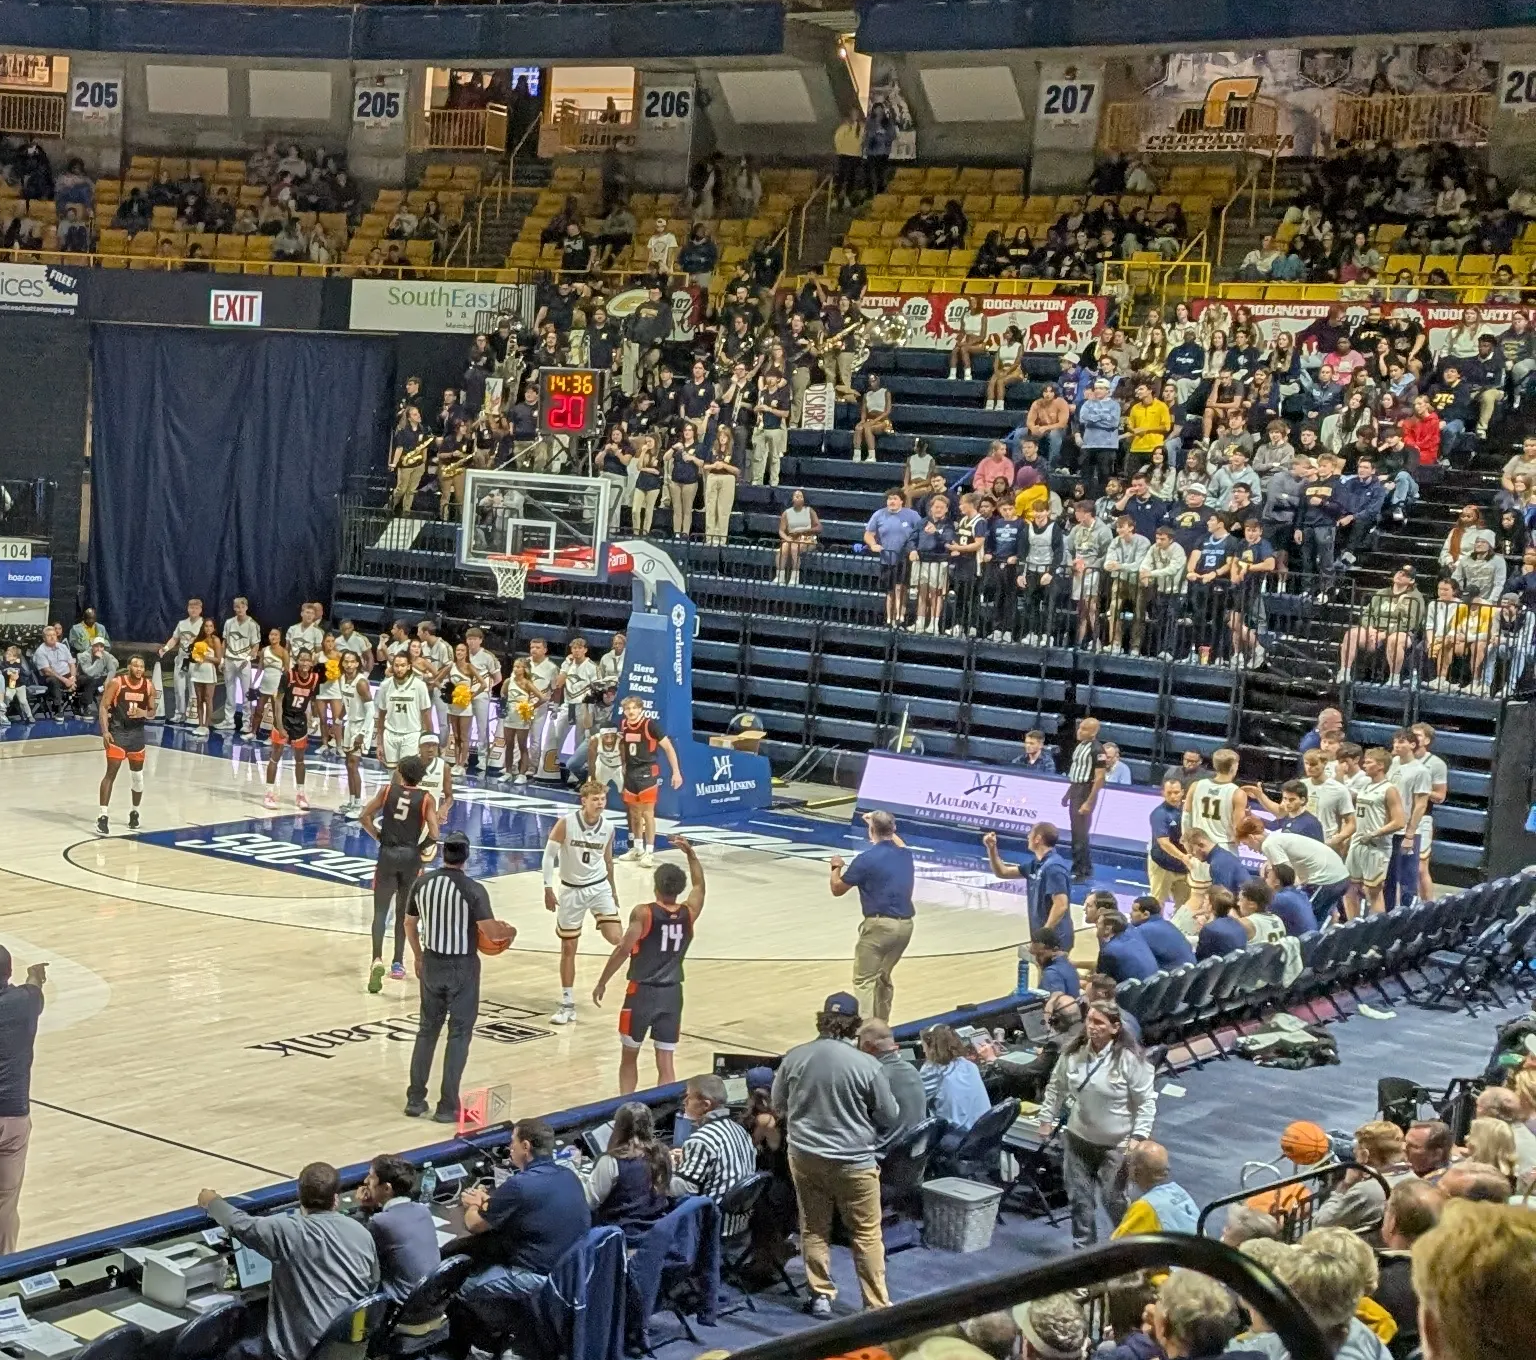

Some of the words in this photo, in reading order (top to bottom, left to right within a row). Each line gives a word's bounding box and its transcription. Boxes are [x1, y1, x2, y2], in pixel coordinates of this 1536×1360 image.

[74, 79, 119, 109] 205
[358, 88, 400, 120] 205
[645, 90, 690, 119] 206
[1044, 84, 1095, 116] 207
[50, 269, 78, 289] FREE!
[388, 285, 499, 308] SouthEast
[214, 293, 259, 324] EXIT
[906, 304, 928, 316] 108
[1071, 308, 1094, 319] 108
[550, 374, 593, 395] 14:36
[548, 396, 585, 428] 20
[1, 544, 28, 558] 104
[673, 627, 683, 685] erlanger
[628, 673, 641, 682] for
[643, 674, 658, 684] the
[633, 664, 655, 674] Here
[395, 704, 408, 714] 34
[394, 797, 410, 820] 5
[914, 808, 930, 817] TAX
[939, 811, 990, 828] ASSURANCE
[1201, 796, 1222, 820] 11
[581, 851, 590, 863] 0
[660, 923, 683, 952] 14
